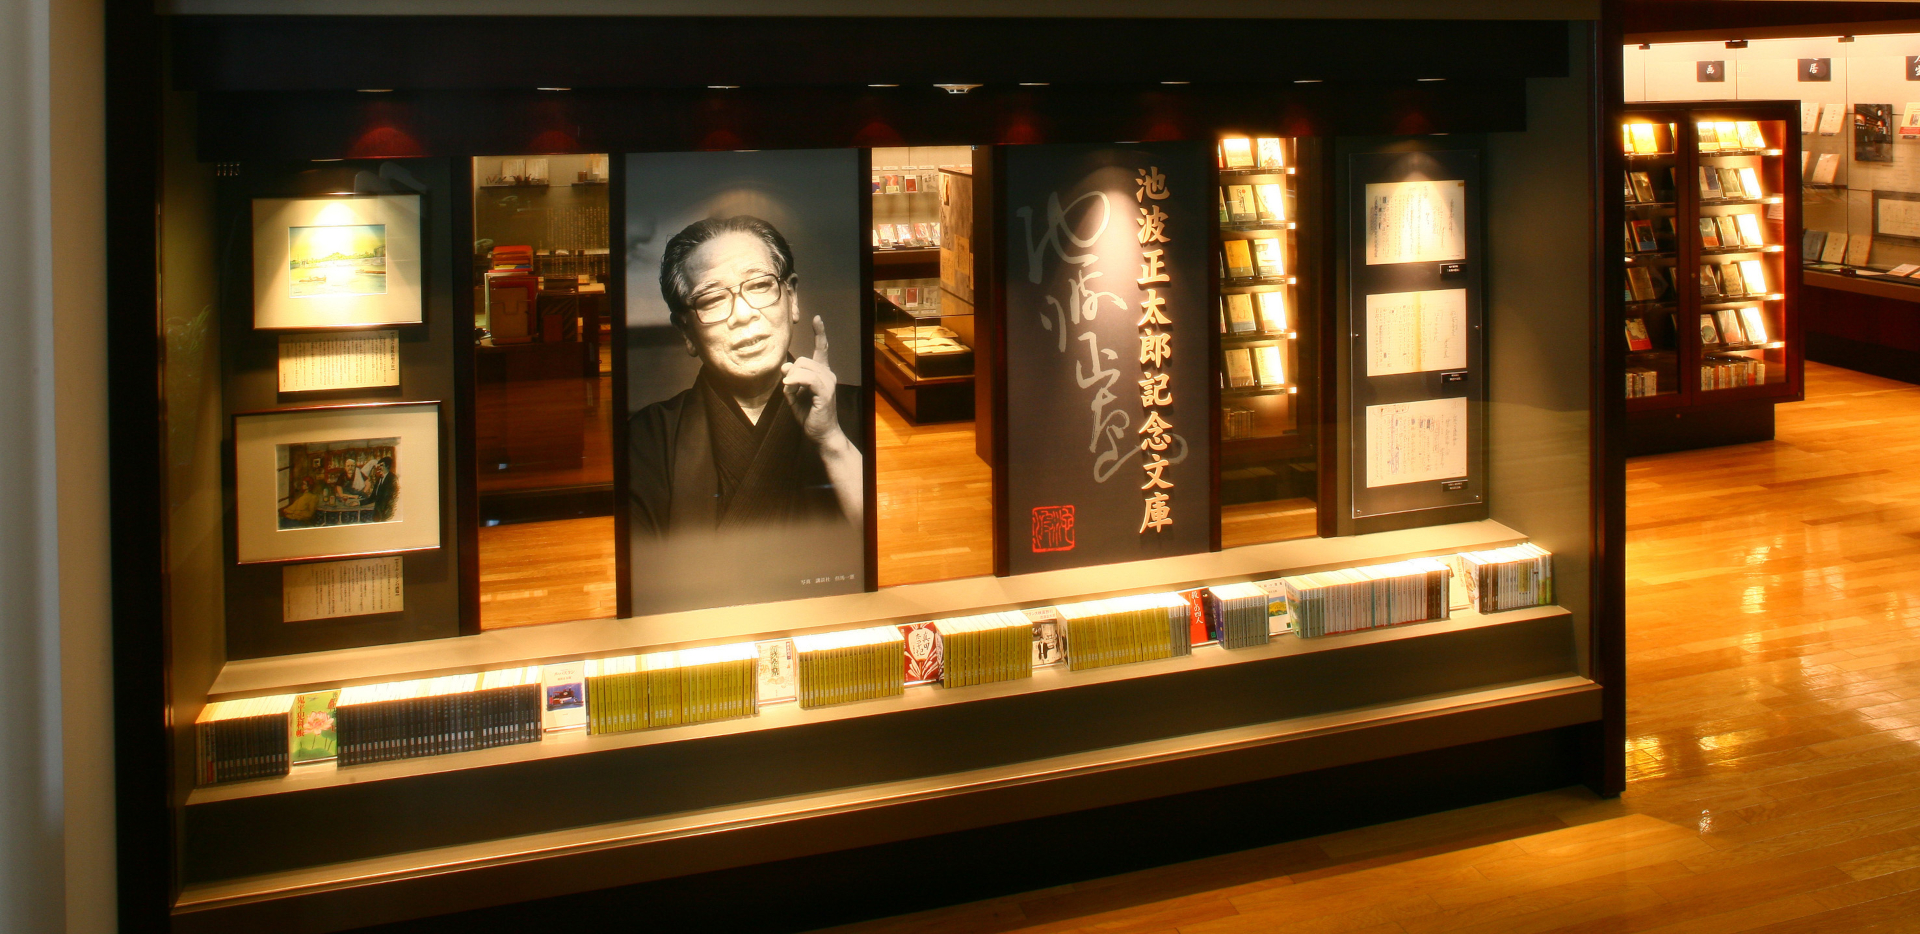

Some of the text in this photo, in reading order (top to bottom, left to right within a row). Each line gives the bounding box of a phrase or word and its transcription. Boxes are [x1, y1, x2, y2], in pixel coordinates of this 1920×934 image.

[1135, 166, 1175, 534] 池波正太郎記念文庫
[1191, 590, 1204, 624] 殺しの四人
